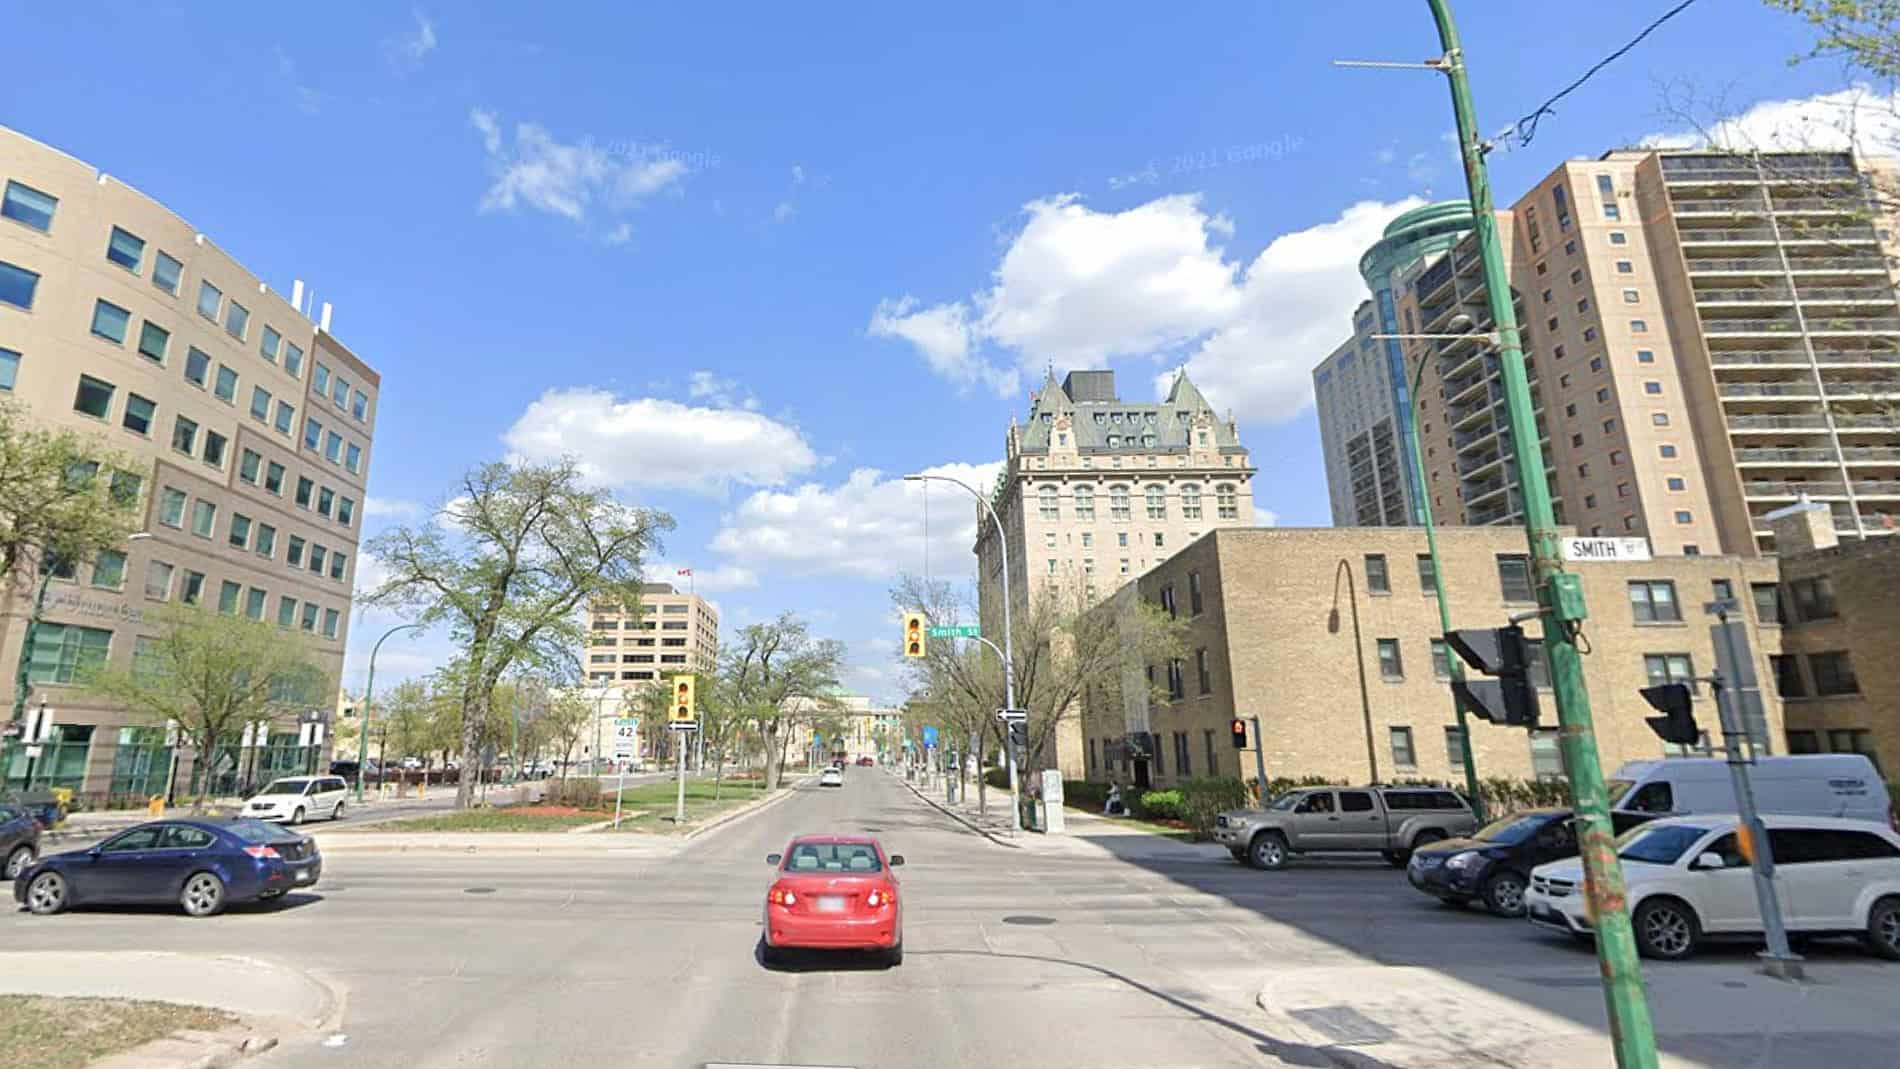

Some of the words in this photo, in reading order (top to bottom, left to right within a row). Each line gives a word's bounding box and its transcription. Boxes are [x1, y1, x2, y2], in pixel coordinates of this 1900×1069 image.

[1572, 541, 1617, 557] SMITH
[931, 627, 962, 636] Smith
[618, 727, 633, 737] 42
